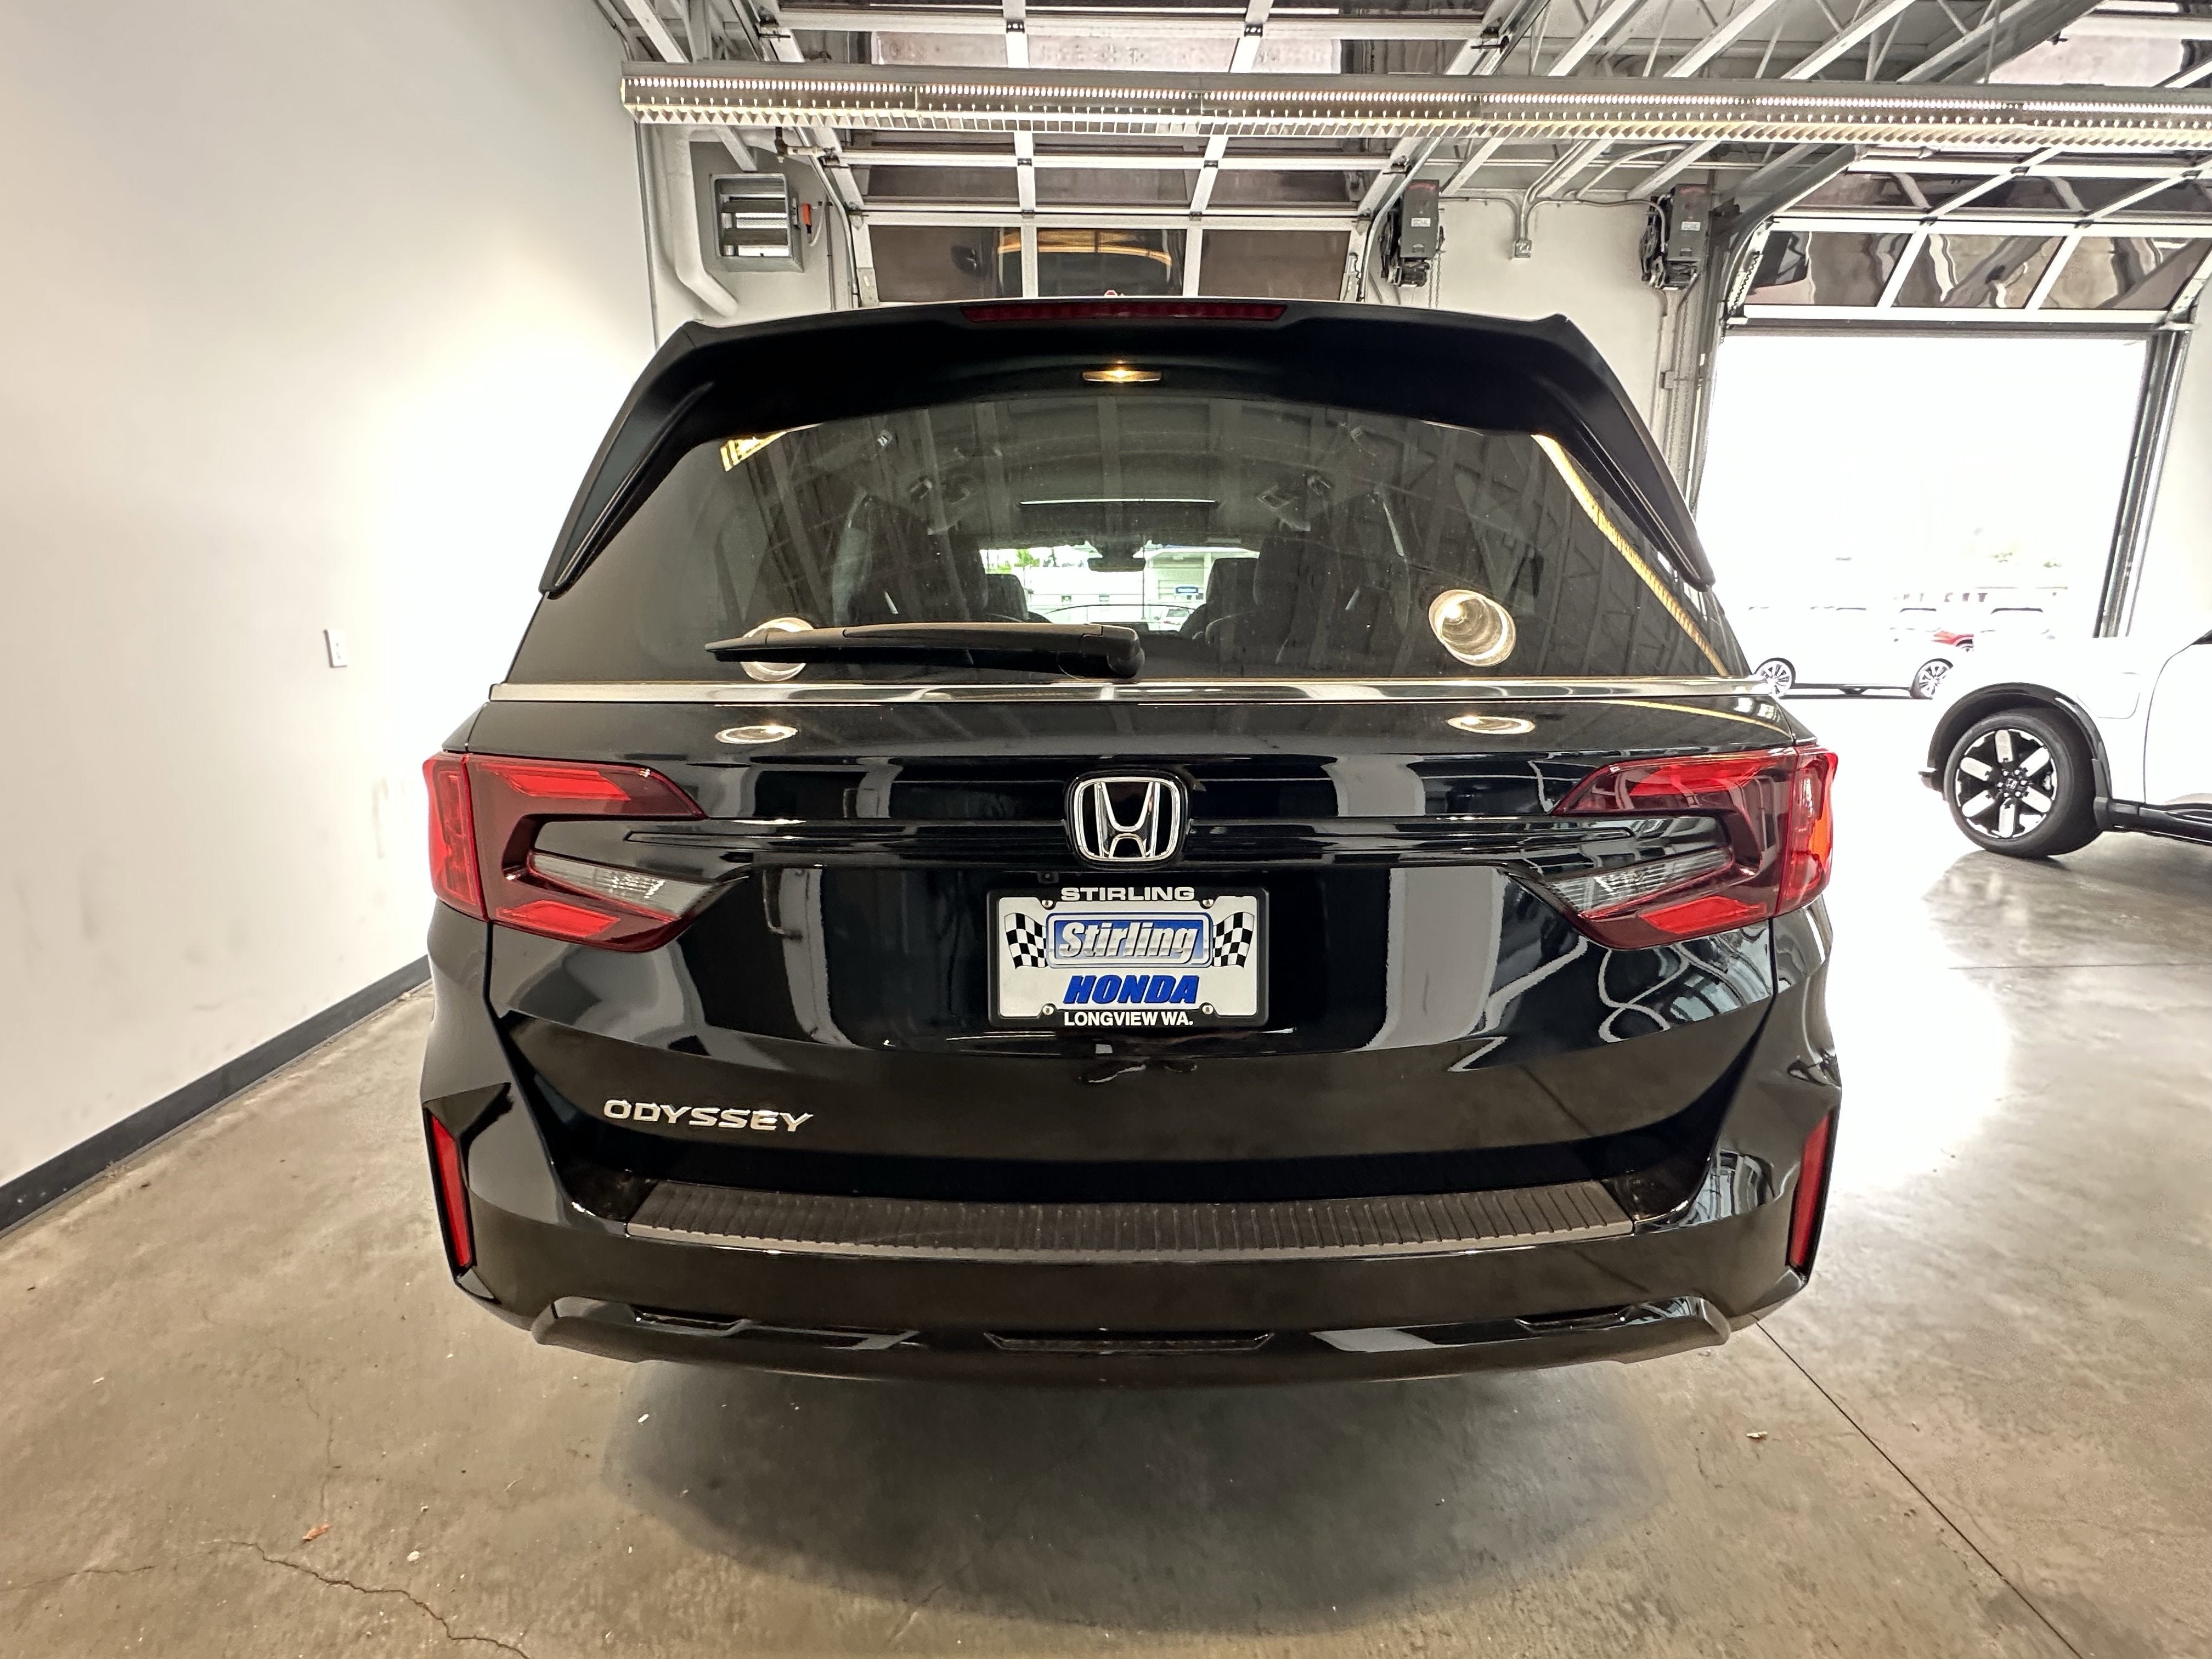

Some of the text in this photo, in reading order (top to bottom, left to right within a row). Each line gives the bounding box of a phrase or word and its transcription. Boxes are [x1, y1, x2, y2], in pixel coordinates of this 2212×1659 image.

[1060, 887, 1195, 901] STIRLING
[1059, 922, 1198, 964] Stirling
[1063, 975, 1199, 1004] HONDA
[1064, 1012, 1194, 1026] LONGVIEW WA.
[604, 1099, 814, 1132] ODYSSEY
